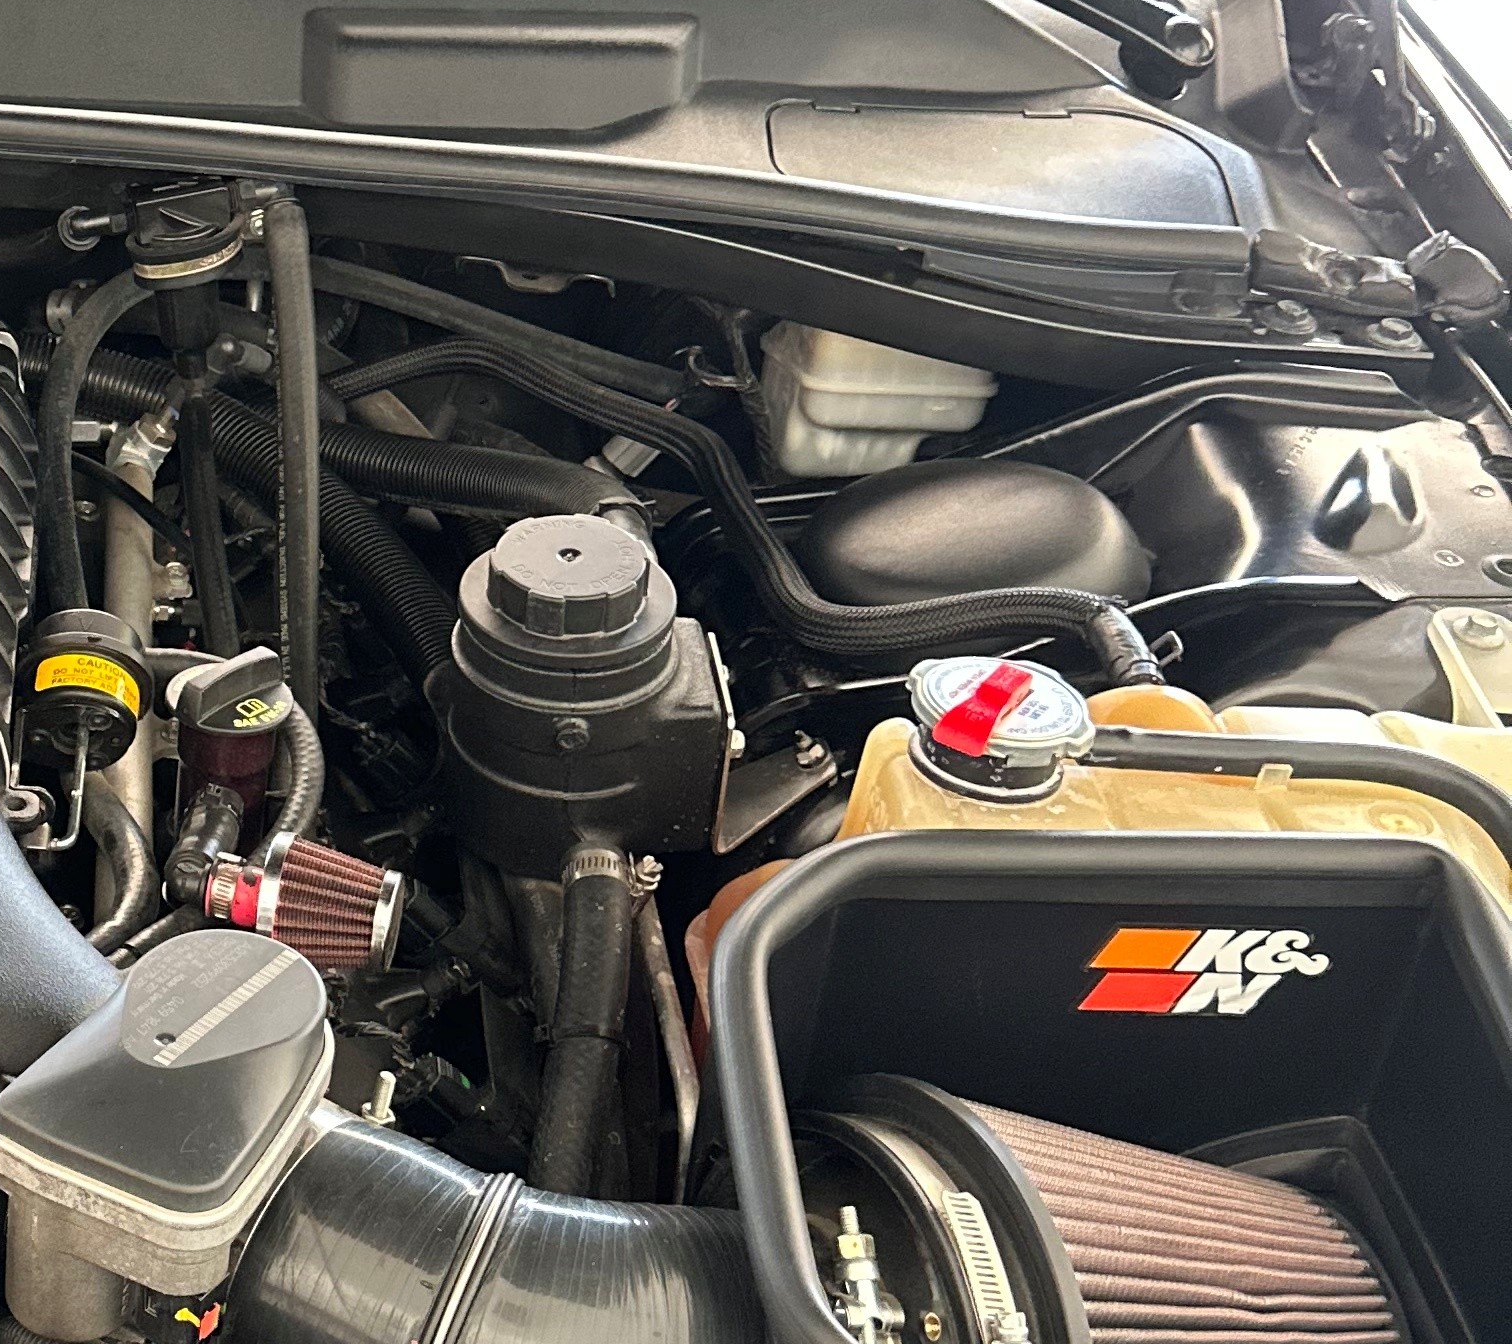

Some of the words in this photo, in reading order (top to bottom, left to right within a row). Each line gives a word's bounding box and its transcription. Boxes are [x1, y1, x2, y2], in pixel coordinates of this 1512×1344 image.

[511, 564, 533, 579] DO
[540, 578, 578, 592] NOT
[590, 564, 631, 590] OPEN
[53, 668, 68, 676] DO
[77, 657, 126, 680] CAUTION
[51, 676, 96, 686] FACTORY
[233, 713, 259, 729] SAE
[1172, 928, 1329, 1014] K&N
